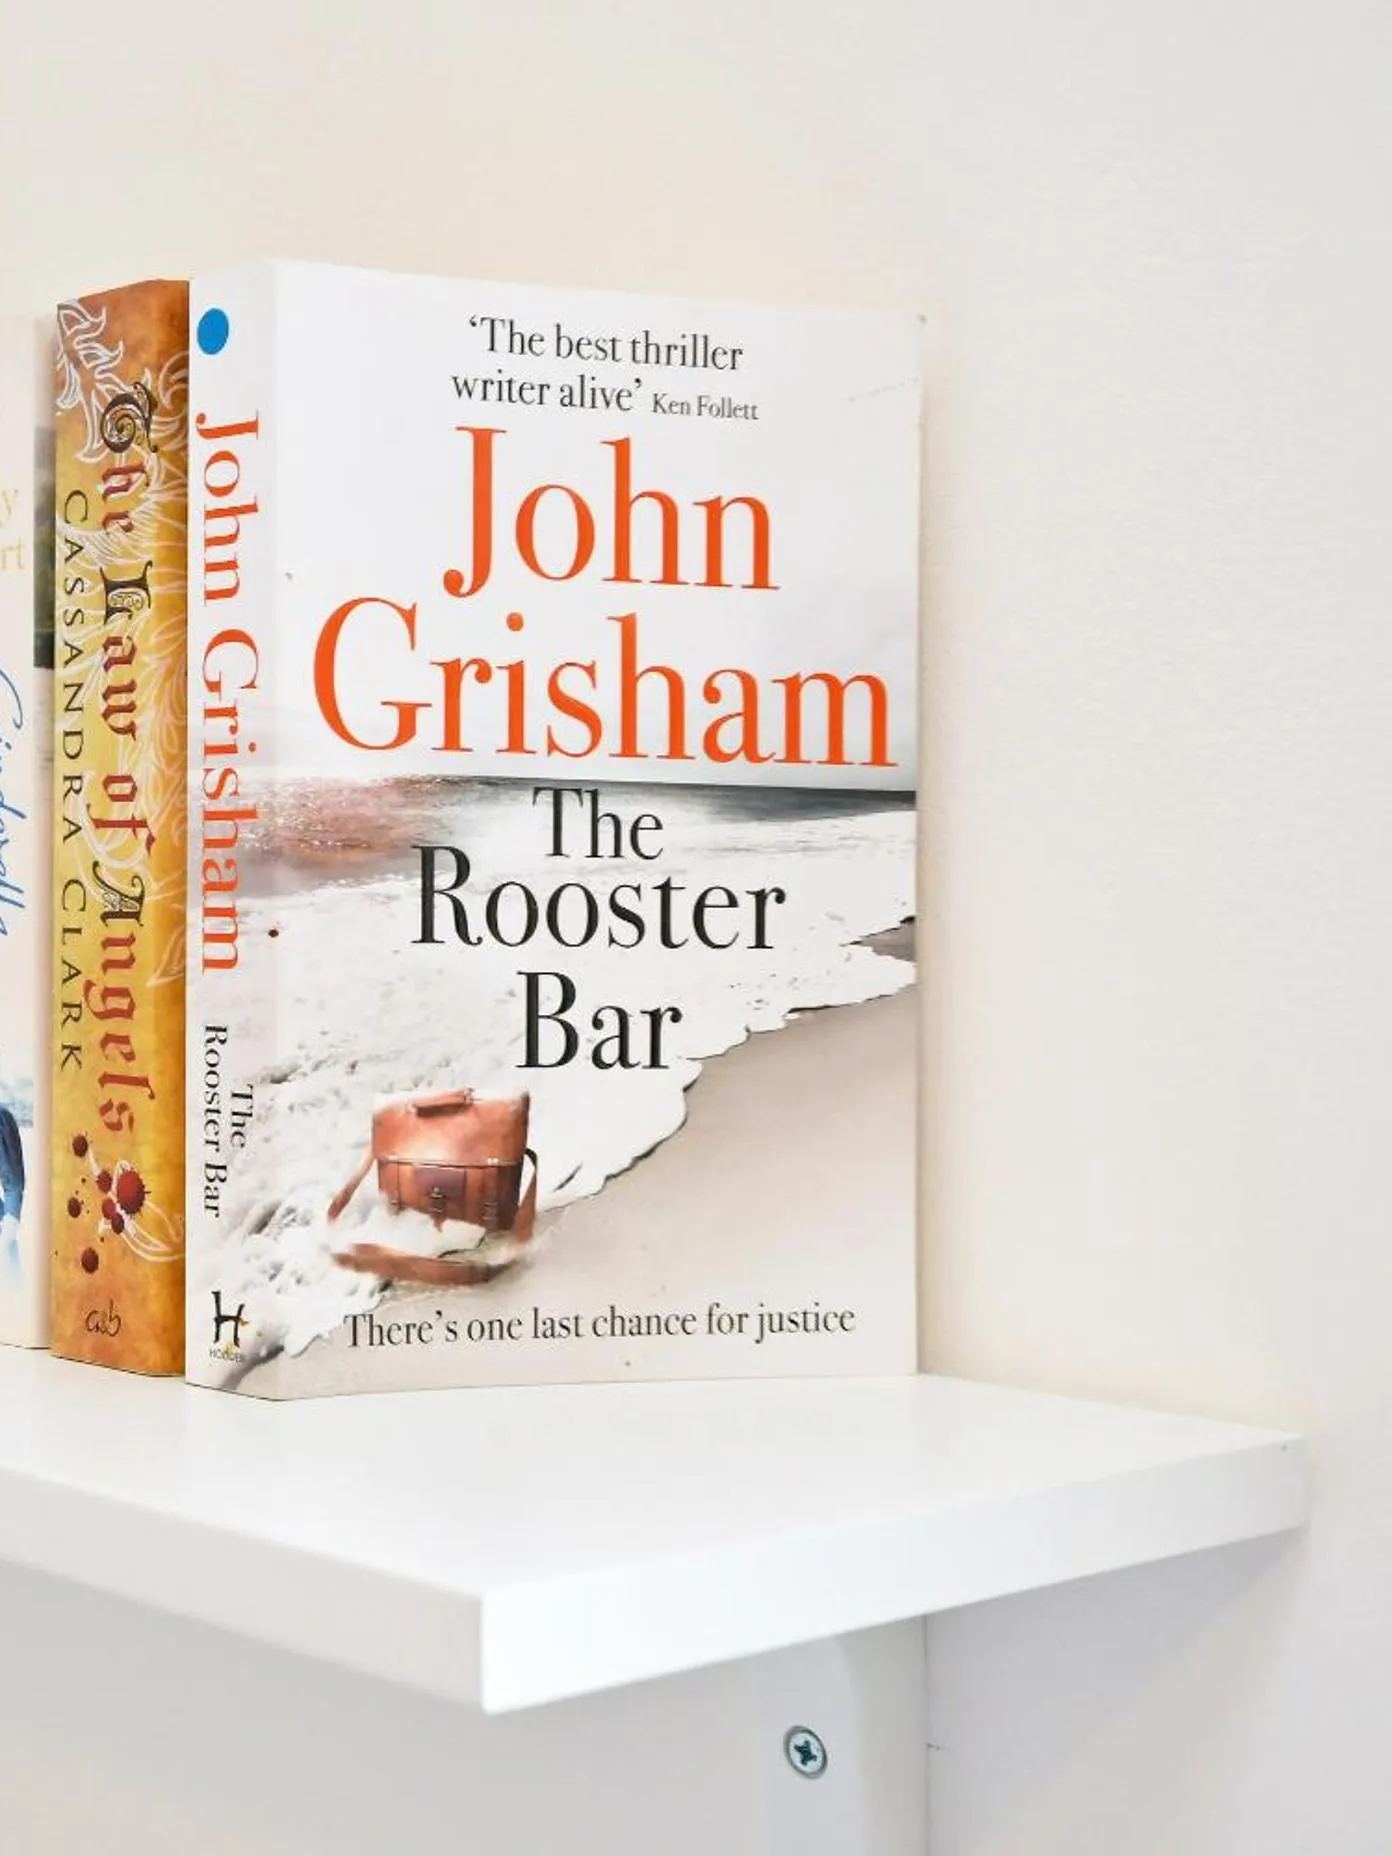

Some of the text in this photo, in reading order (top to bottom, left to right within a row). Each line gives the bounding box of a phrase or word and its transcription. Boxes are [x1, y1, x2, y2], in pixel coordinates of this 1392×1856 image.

[452, 369, 550, 407] writer
[651, 393, 691, 417] Ken
[696, 395, 759, 421] Follett
[555, 323, 622, 363] best
[630, 330, 744, 372] thriller
[313, 426, 898, 767] John Grisham
[195, 411, 260, 974] John Grisham
[60, 489, 89, 1073] CASSANDRA CLARK
[82, 381, 158, 1133] The Law of Angels
[533, 787, 664, 861] The
[411, 844, 787, 950] Rooster
[516, 971, 684, 1070] Bar
[203, 1024, 228, 1217] Rooster Bar
[230, 1083, 253, 1150] The
[467, 1318, 525, 1341] one
[532, 1310, 583, 1341] last
[591, 1305, 697, 1339] chance
[706, 1304, 749, 1337] for
[754, 1304, 856, 1344] justice
